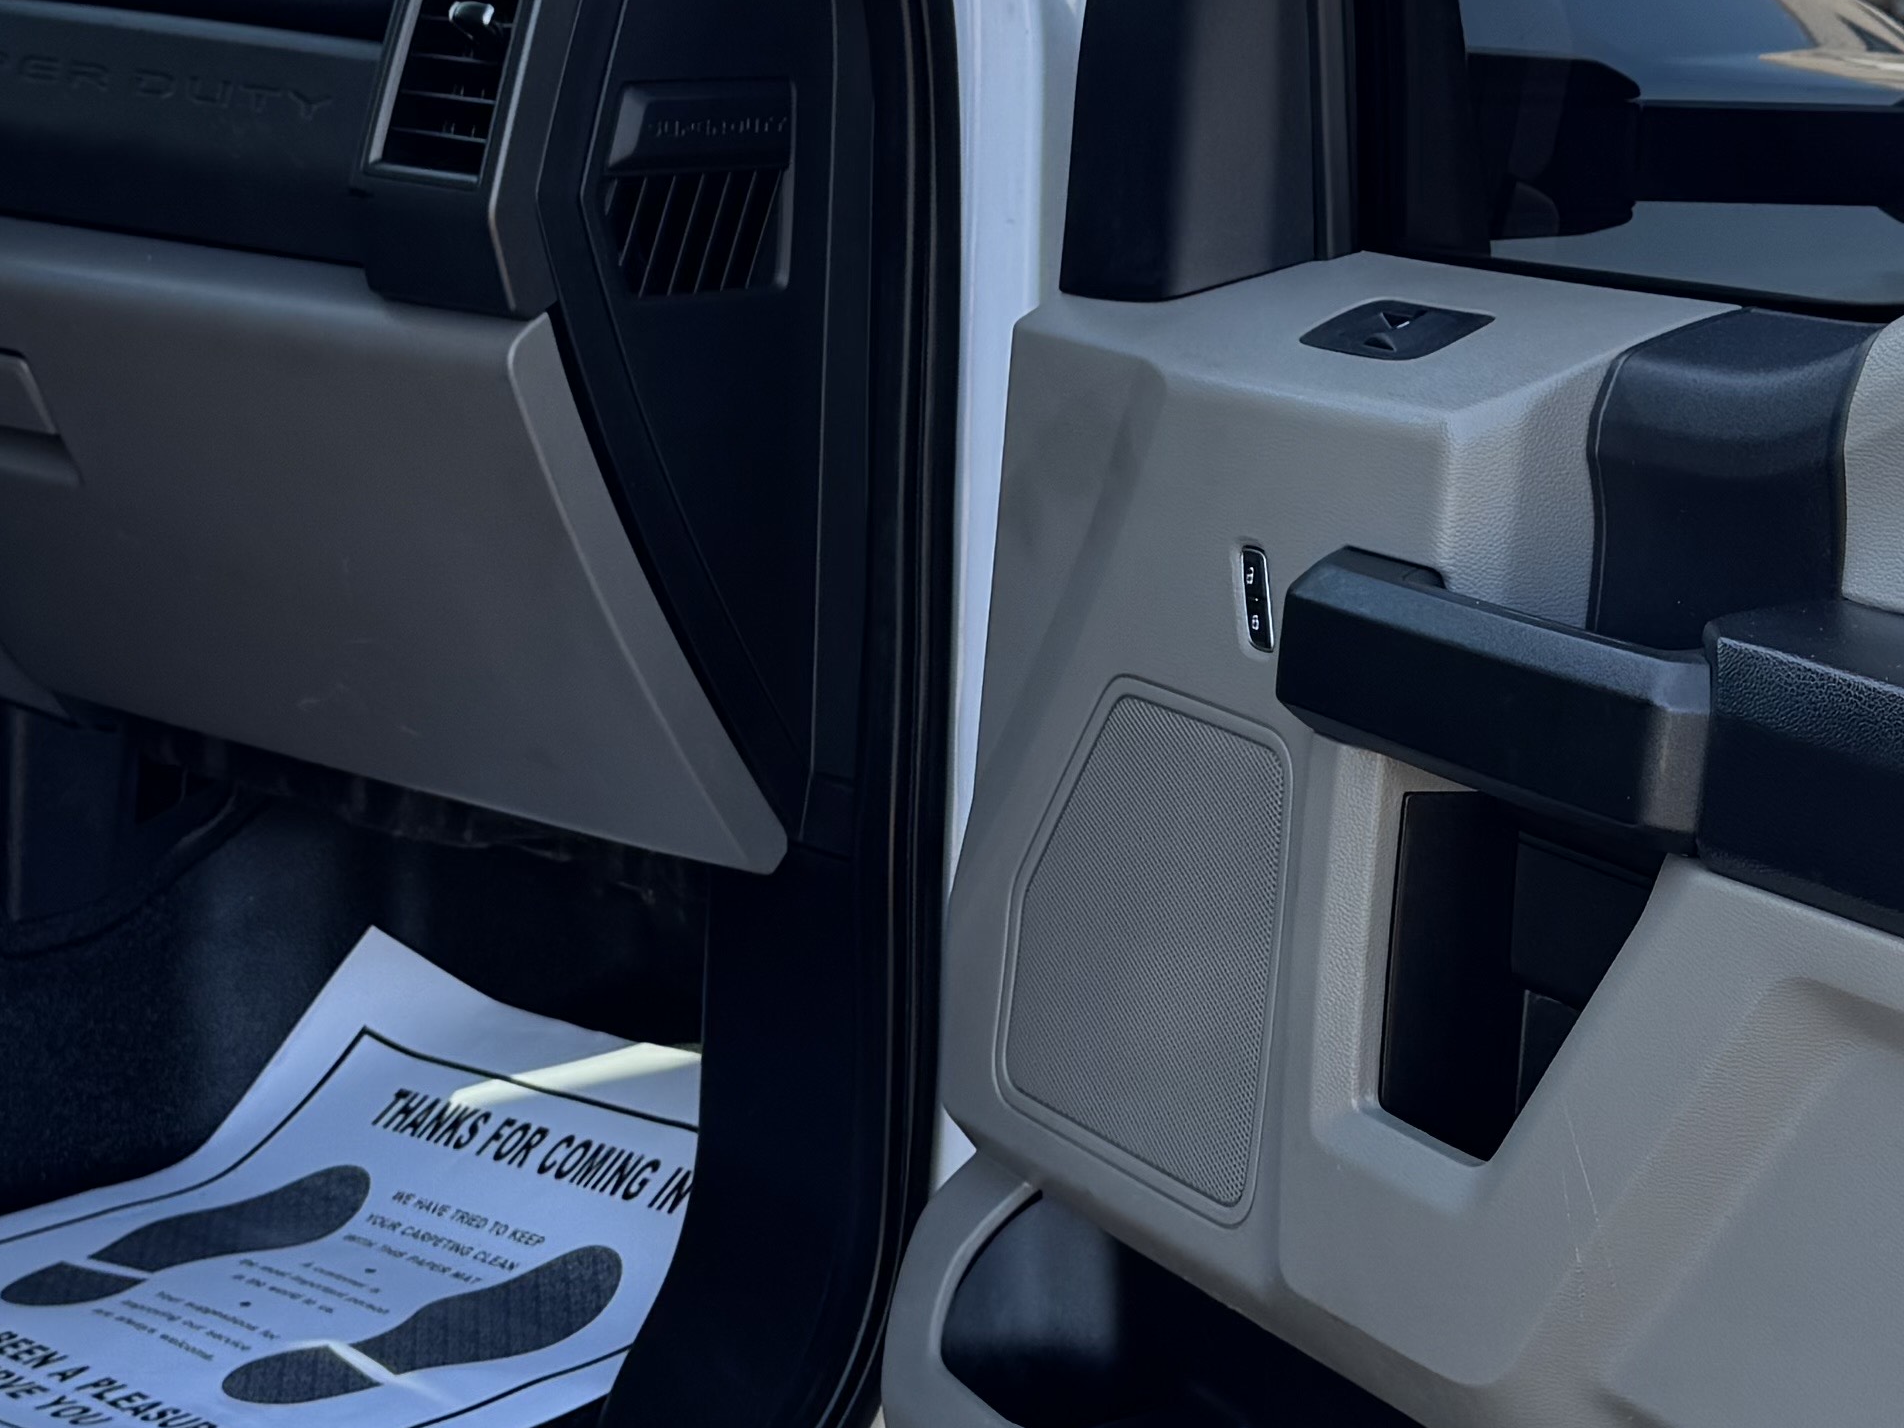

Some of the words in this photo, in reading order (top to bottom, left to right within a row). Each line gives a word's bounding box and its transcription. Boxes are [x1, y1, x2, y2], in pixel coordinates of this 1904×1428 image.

[133, 66, 334, 123] DUTY
[371, 1088, 491, 1150] THANKS
[475, 1118, 550, 1168] FOR
[537, 1134, 661, 1201] COMING
[647, 1166, 694, 1214] IN
[366, 1212, 402, 1232] YOUR
[400, 1225, 474, 1257] CARPETING
[473, 1249, 521, 1273] CLEAN
[392, 1190, 416, 1206] WE
[413, 1197, 451, 1218] HAVE
[450, 1208, 489, 1229] TRIED
[488, 1221, 510, 1236] TO
[507, 1226, 545, 1247] KEEP
[343, 1232, 376, 1248] WITH
[379, 1243, 408, 1258] THIS
[406, 1254, 452, 1275] PAPER
[450, 1270, 483, 1285] MAT
[48, 1364, 92, 1383] A
[34, 1394, 114, 1427] YOU
